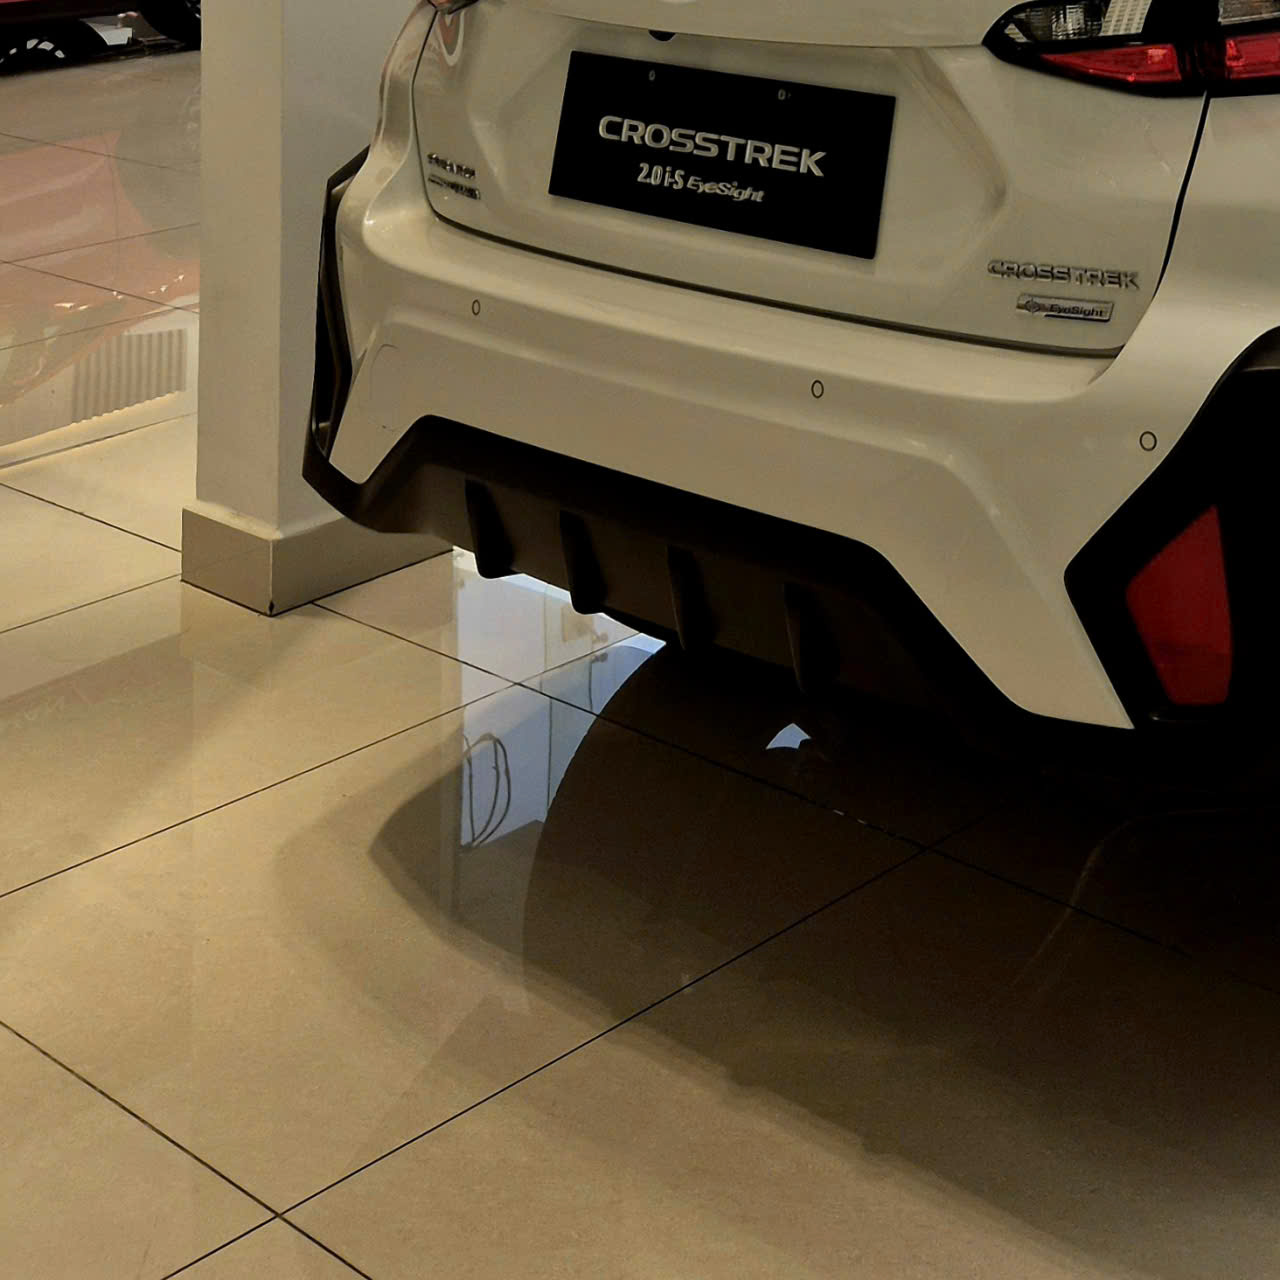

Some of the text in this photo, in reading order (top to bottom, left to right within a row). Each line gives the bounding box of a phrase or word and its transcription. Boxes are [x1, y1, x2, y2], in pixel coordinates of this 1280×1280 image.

[598, 115, 828, 177] CROSSTREK
[686, 175, 765, 203] EyeSight
[987, 259, 1141, 290] CROSSTREK
[1049, 303, 1104, 318] EyeSight
